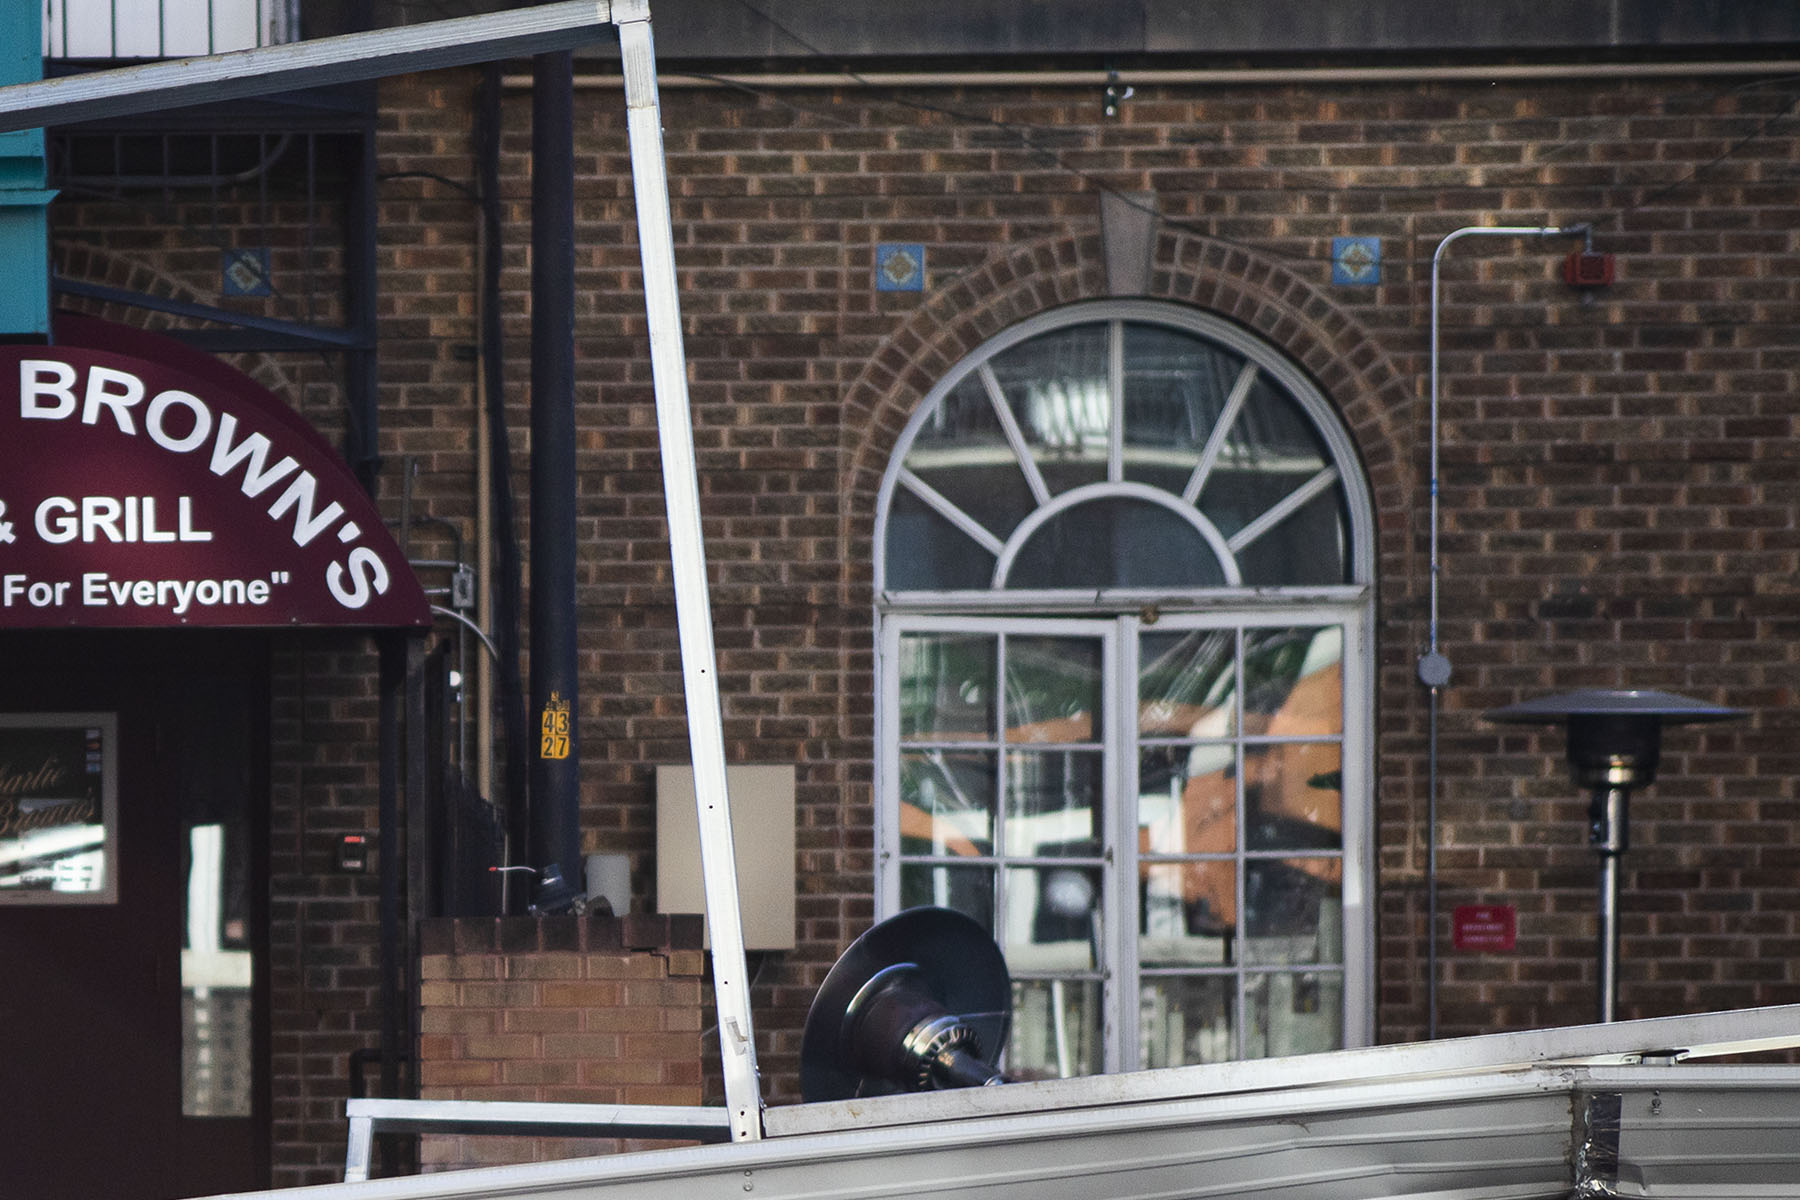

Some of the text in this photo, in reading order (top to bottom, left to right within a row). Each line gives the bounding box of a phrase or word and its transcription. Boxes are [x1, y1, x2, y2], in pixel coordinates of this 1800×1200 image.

[20, 359, 390, 609] BROWN'S
[34, 494, 214, 545] GRILL
[3, 574, 71, 607] For
[82, 571, 290, 615] Everyone"
[543, 711, 569, 734] 43
[543, 736, 568, 757] 27
